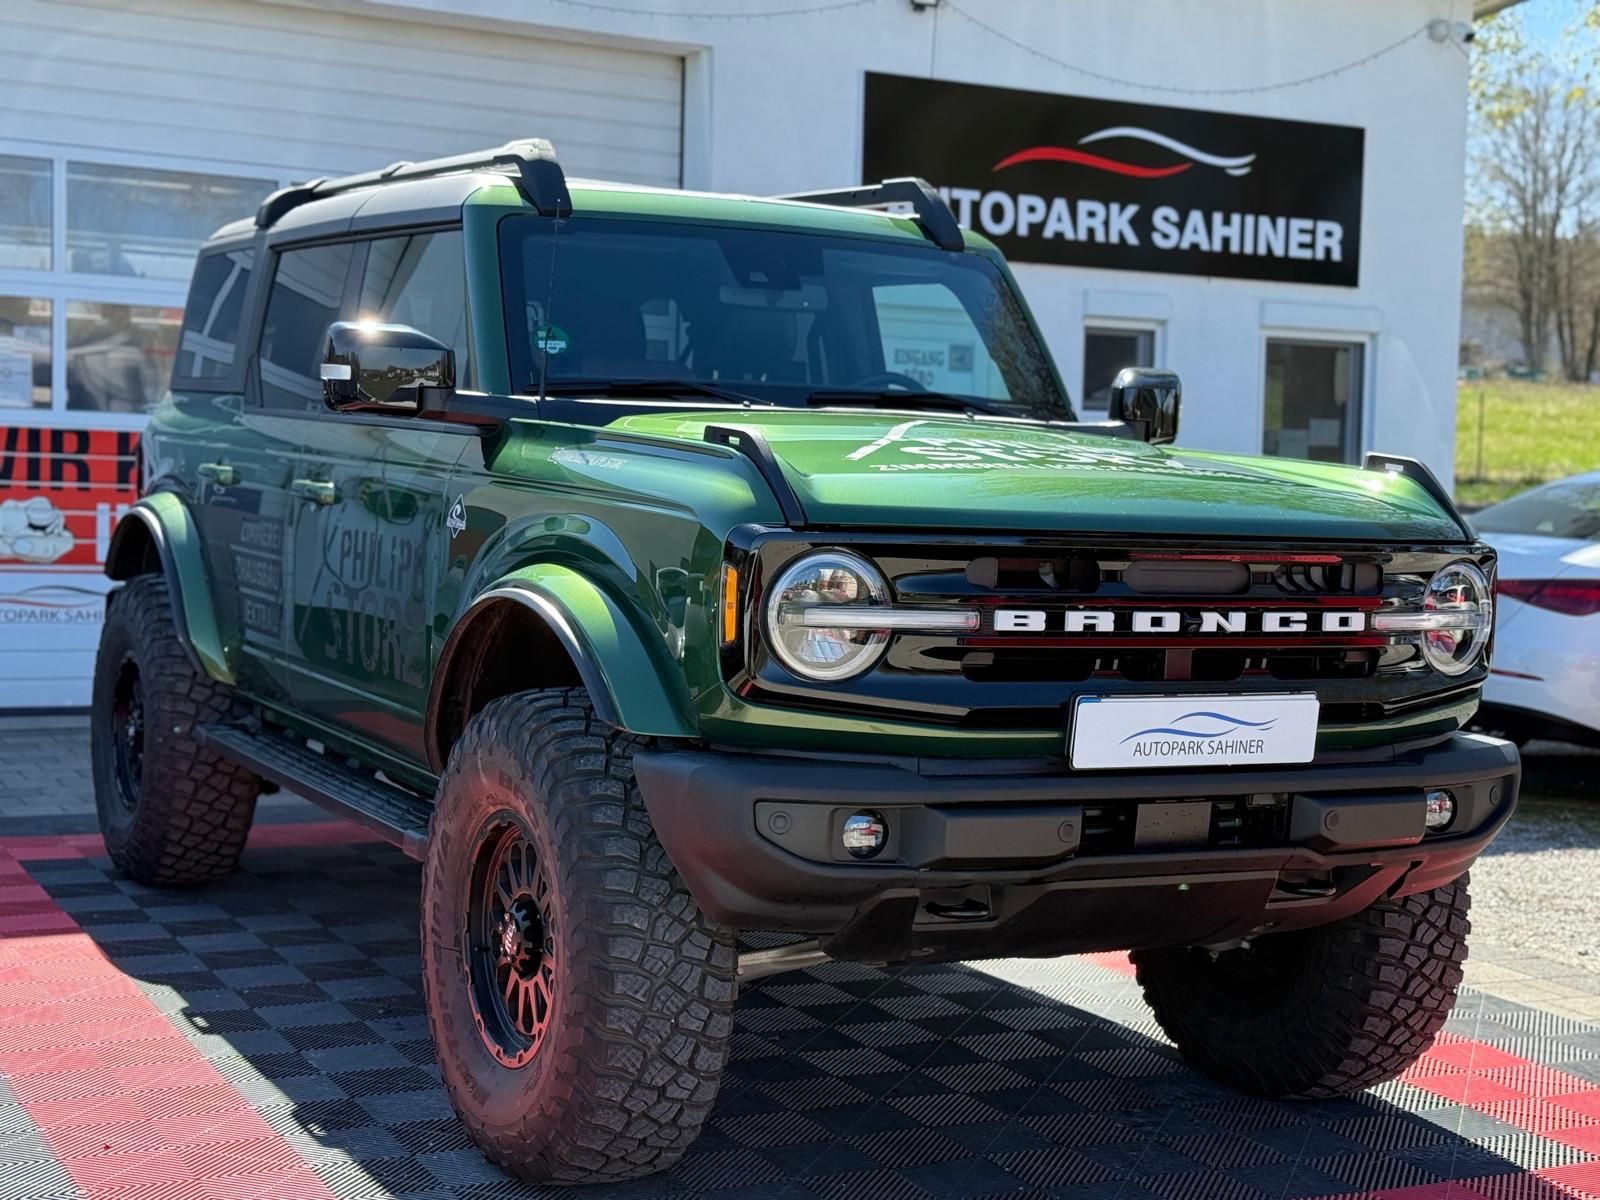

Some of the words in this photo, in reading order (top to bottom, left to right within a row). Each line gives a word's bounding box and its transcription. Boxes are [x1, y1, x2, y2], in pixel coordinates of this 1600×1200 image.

[887, 186, 1139, 246] TOPARK
[1151, 205, 1343, 263] SAHINER
[994, 609, 1366, 632] BRONCO
[1133, 740, 1205, 757] AUTOPARK
[1208, 739, 1264, 755] SAHINER
